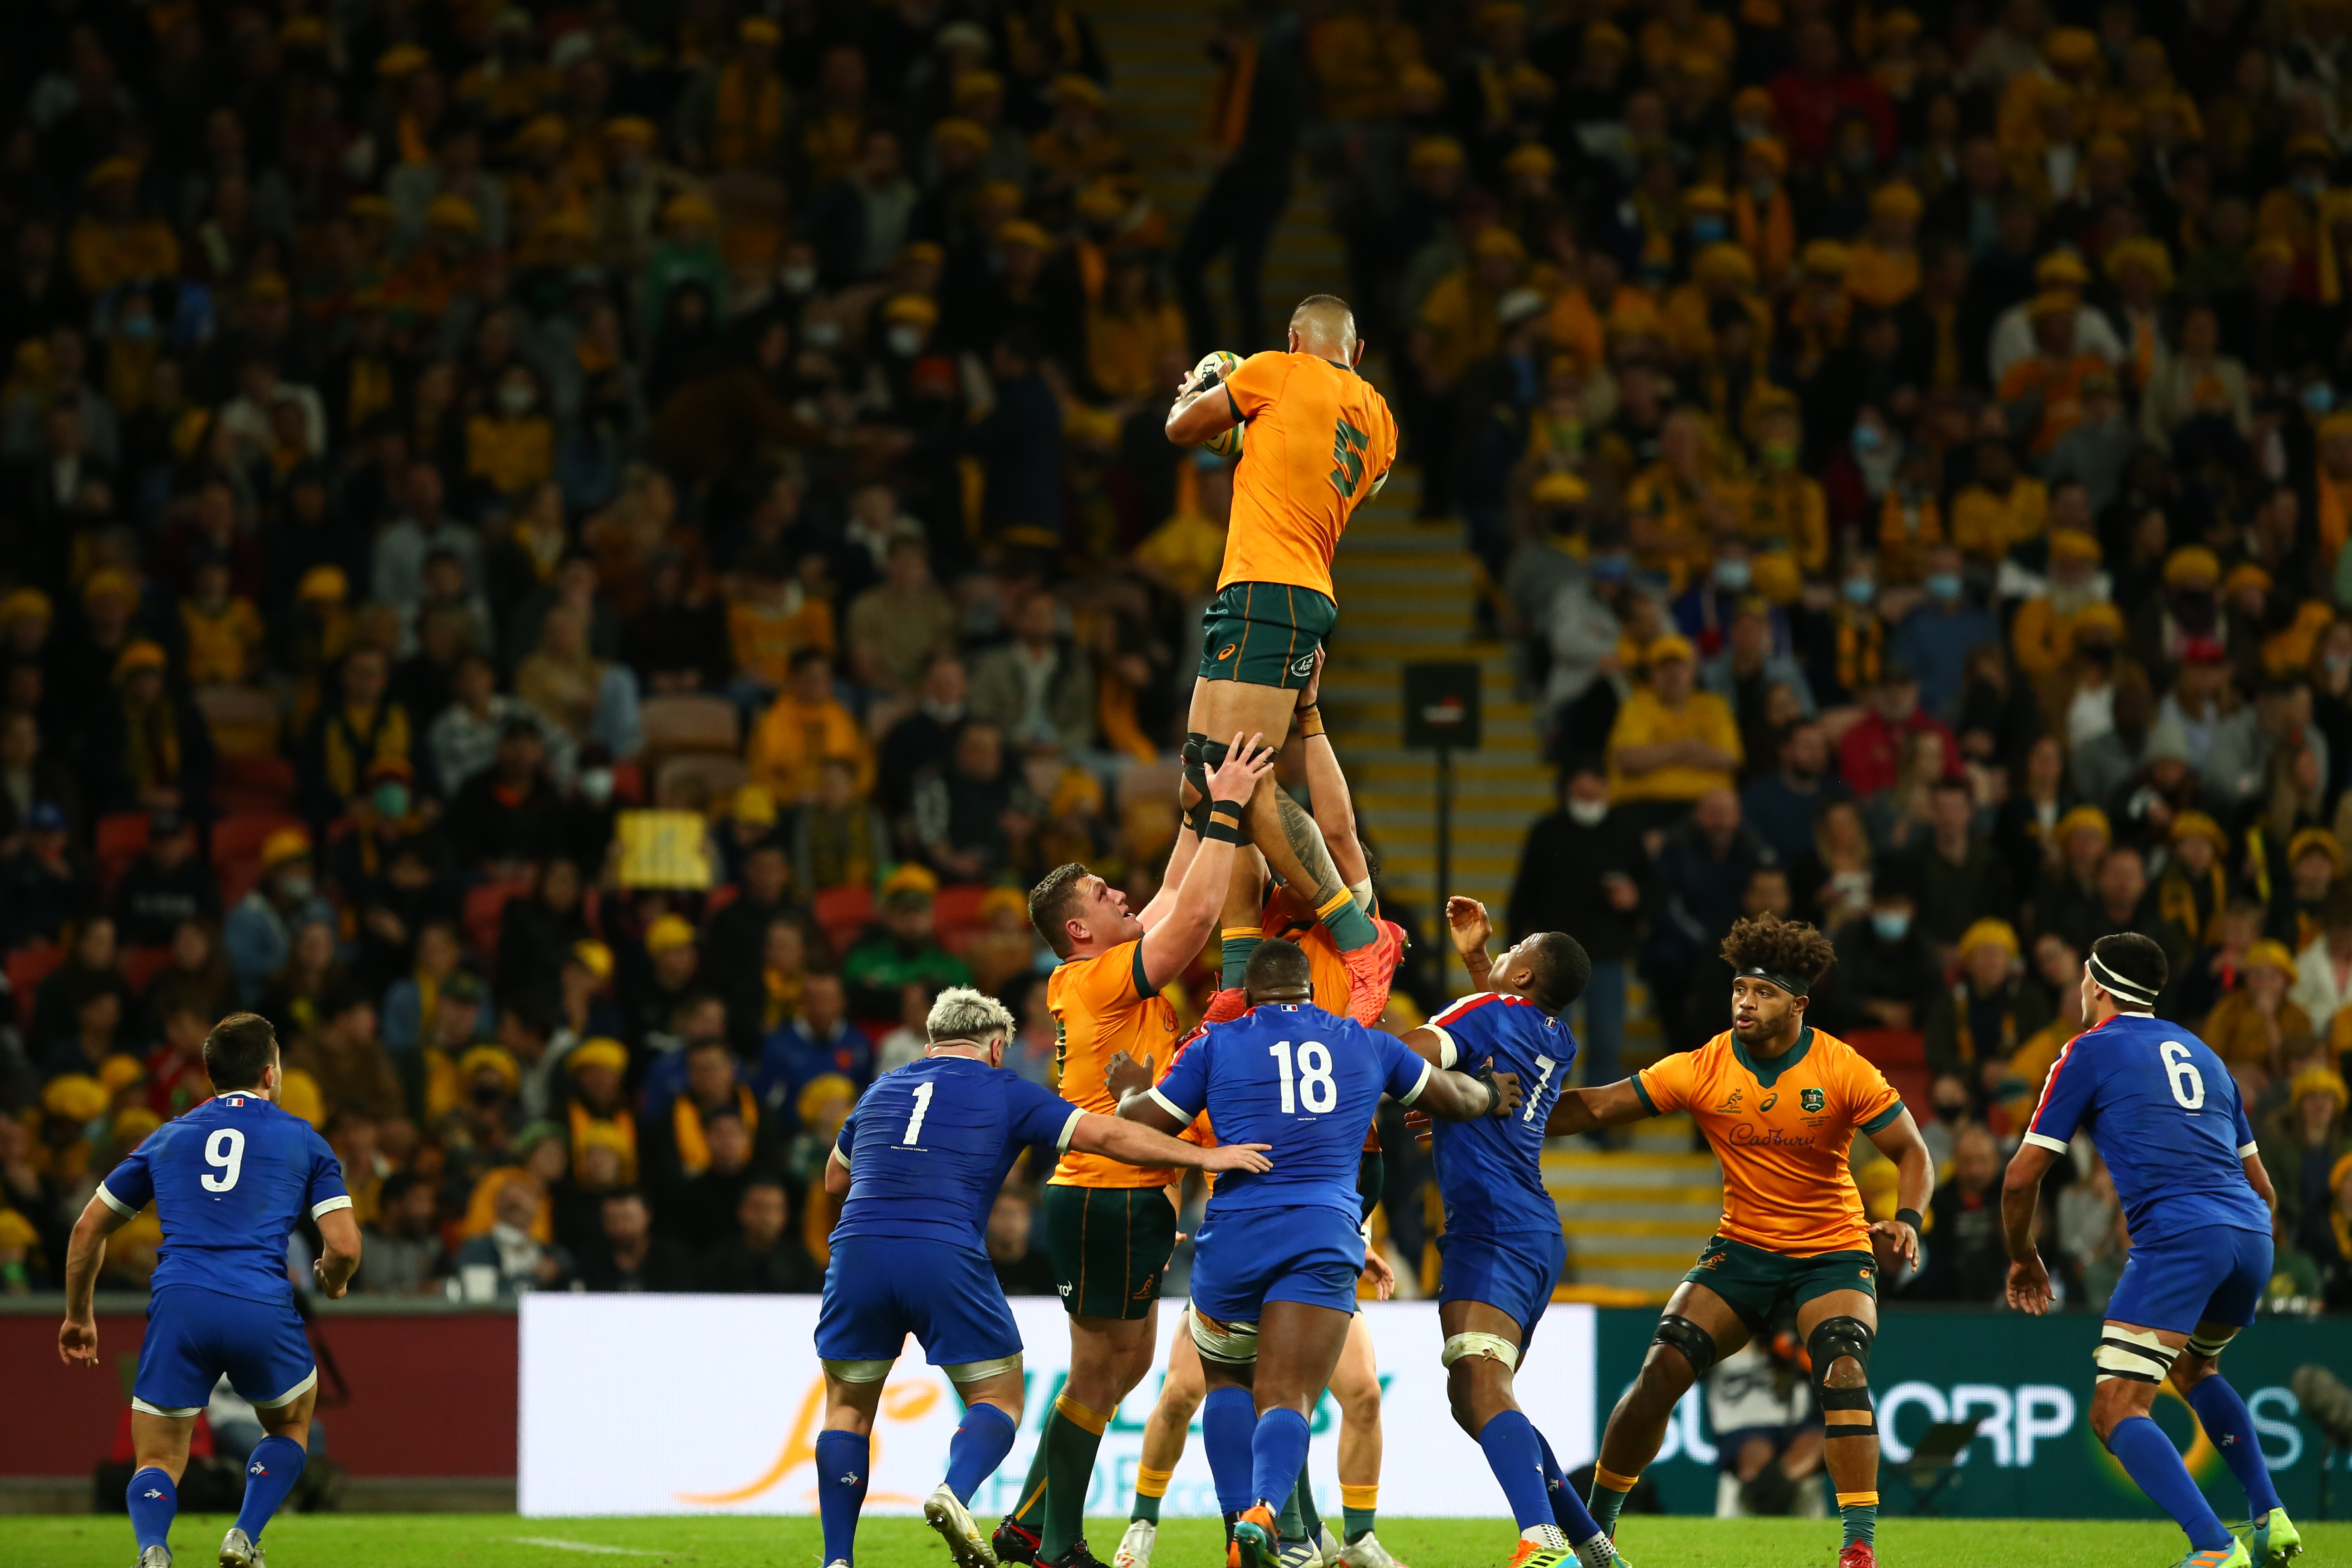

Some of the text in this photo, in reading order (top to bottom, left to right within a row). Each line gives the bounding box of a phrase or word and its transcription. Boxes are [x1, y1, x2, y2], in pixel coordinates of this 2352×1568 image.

[1330, 418, 1369, 498] 5
[1269, 1041, 1337, 1113] 18
[1523, 1054, 1557, 1122] 7
[2160, 1040, 2205, 1109] 6
[902, 1082, 934, 1145] 1
[1729, 1122, 1815, 1151] Cadbury
[201, 1128, 245, 1192] 9
